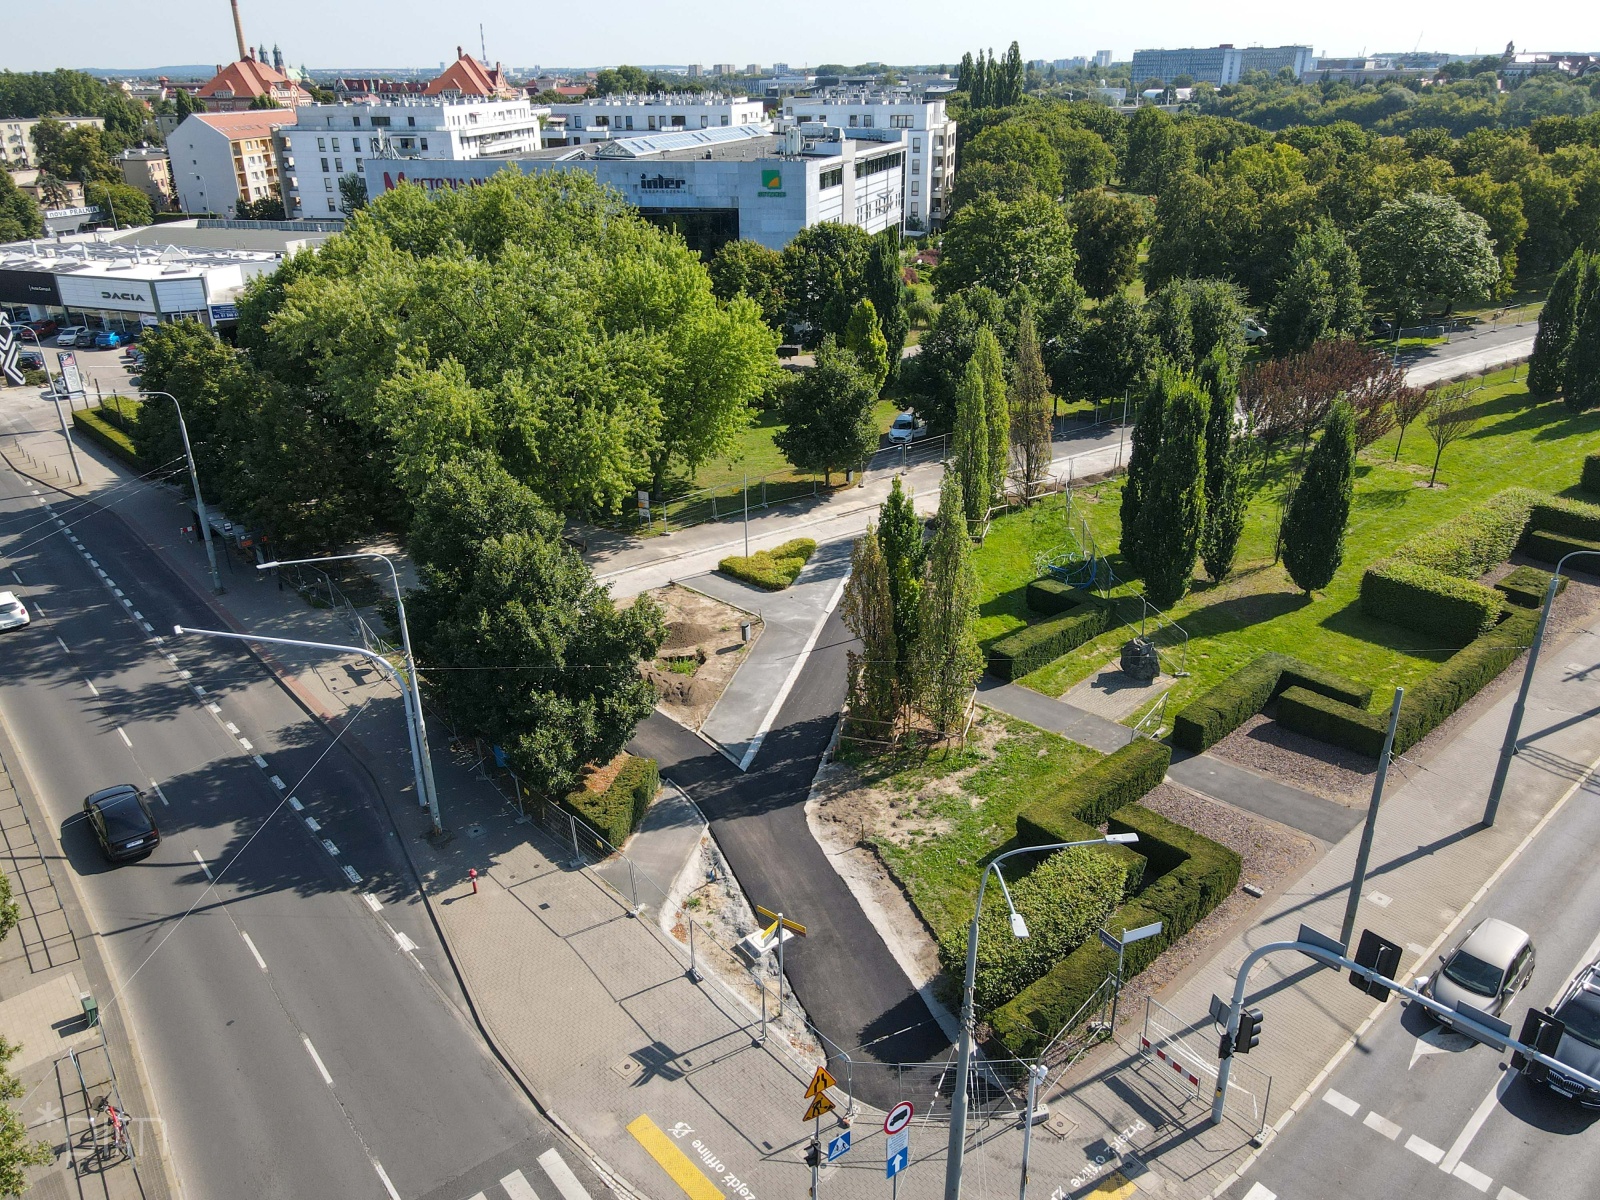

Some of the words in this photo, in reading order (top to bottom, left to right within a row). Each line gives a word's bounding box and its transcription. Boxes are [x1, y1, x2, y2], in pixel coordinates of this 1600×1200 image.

[641, 173, 686, 188] inter
[69, 206, 97, 216] PRALNIA
[101, 291, 145, 301] DACIA
[691, 1139, 726, 1173] offline
